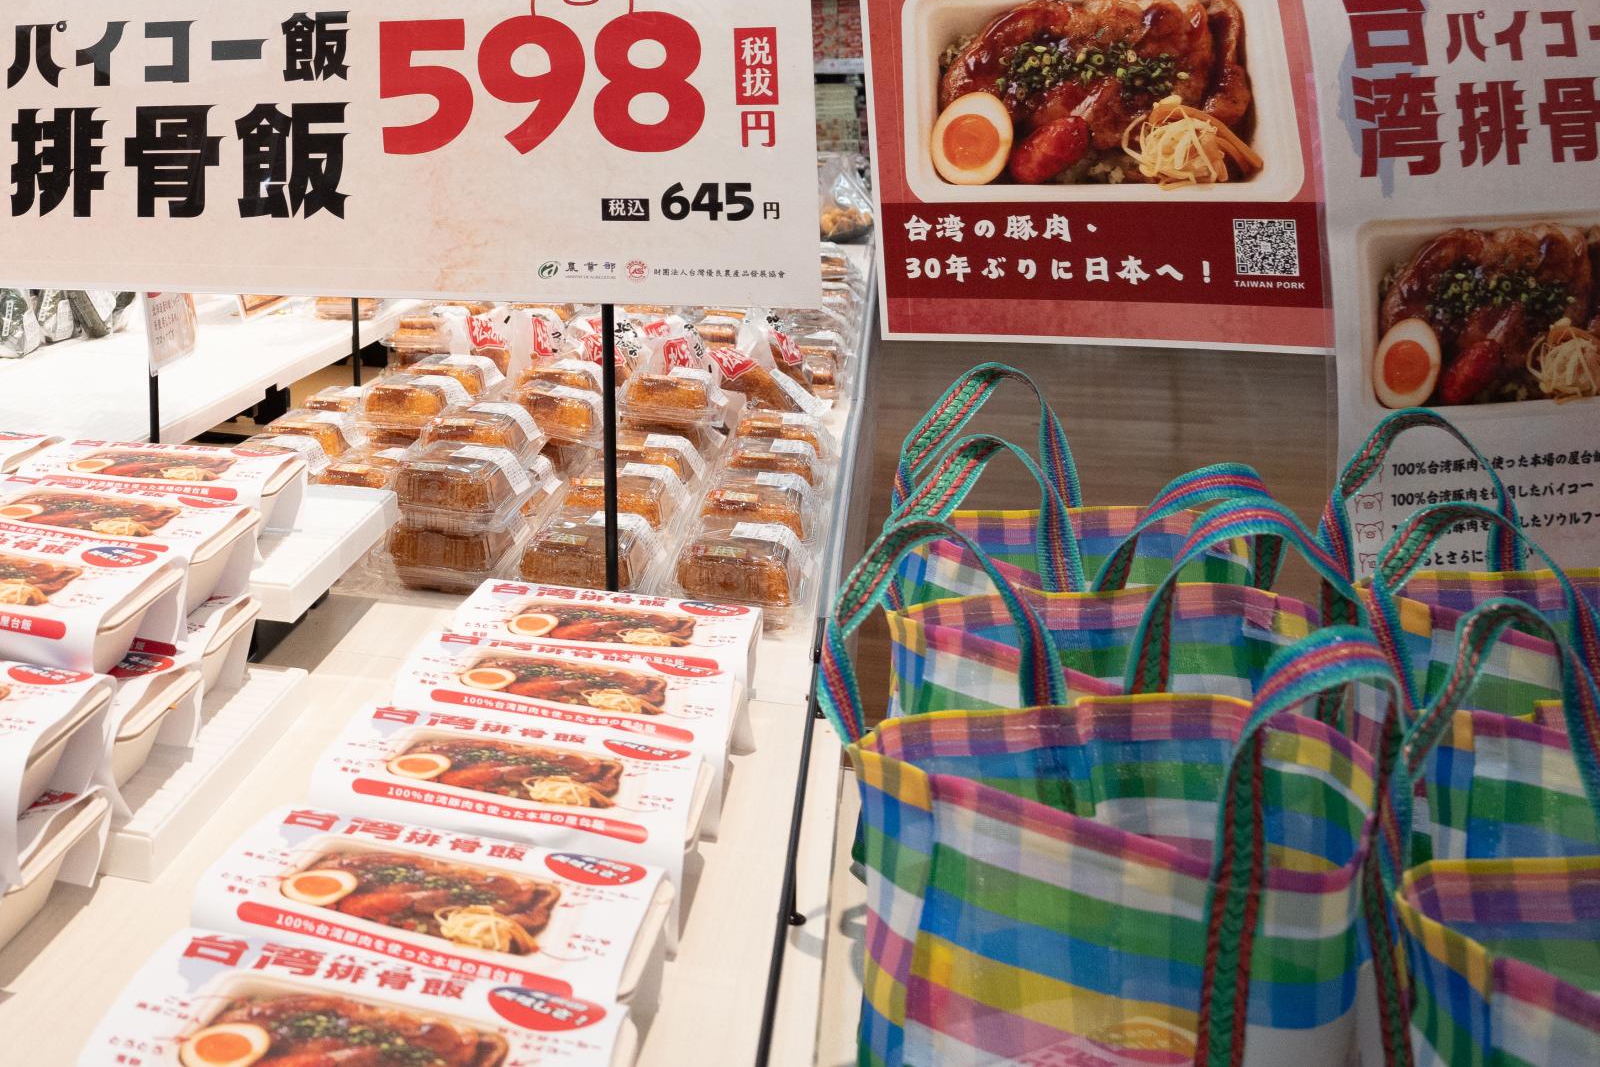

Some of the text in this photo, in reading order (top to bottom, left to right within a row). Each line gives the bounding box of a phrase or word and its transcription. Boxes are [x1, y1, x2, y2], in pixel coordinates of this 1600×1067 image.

[6, 10, 352, 90] パイコー飯
[1446, 10, 1600, 63] パイコ
[378, 10, 706, 155] 598
[10, 101, 353, 220] 排骨飯
[660, 181, 755, 222] 645
[1234, 280, 1306, 289] TAIWAN PORK
